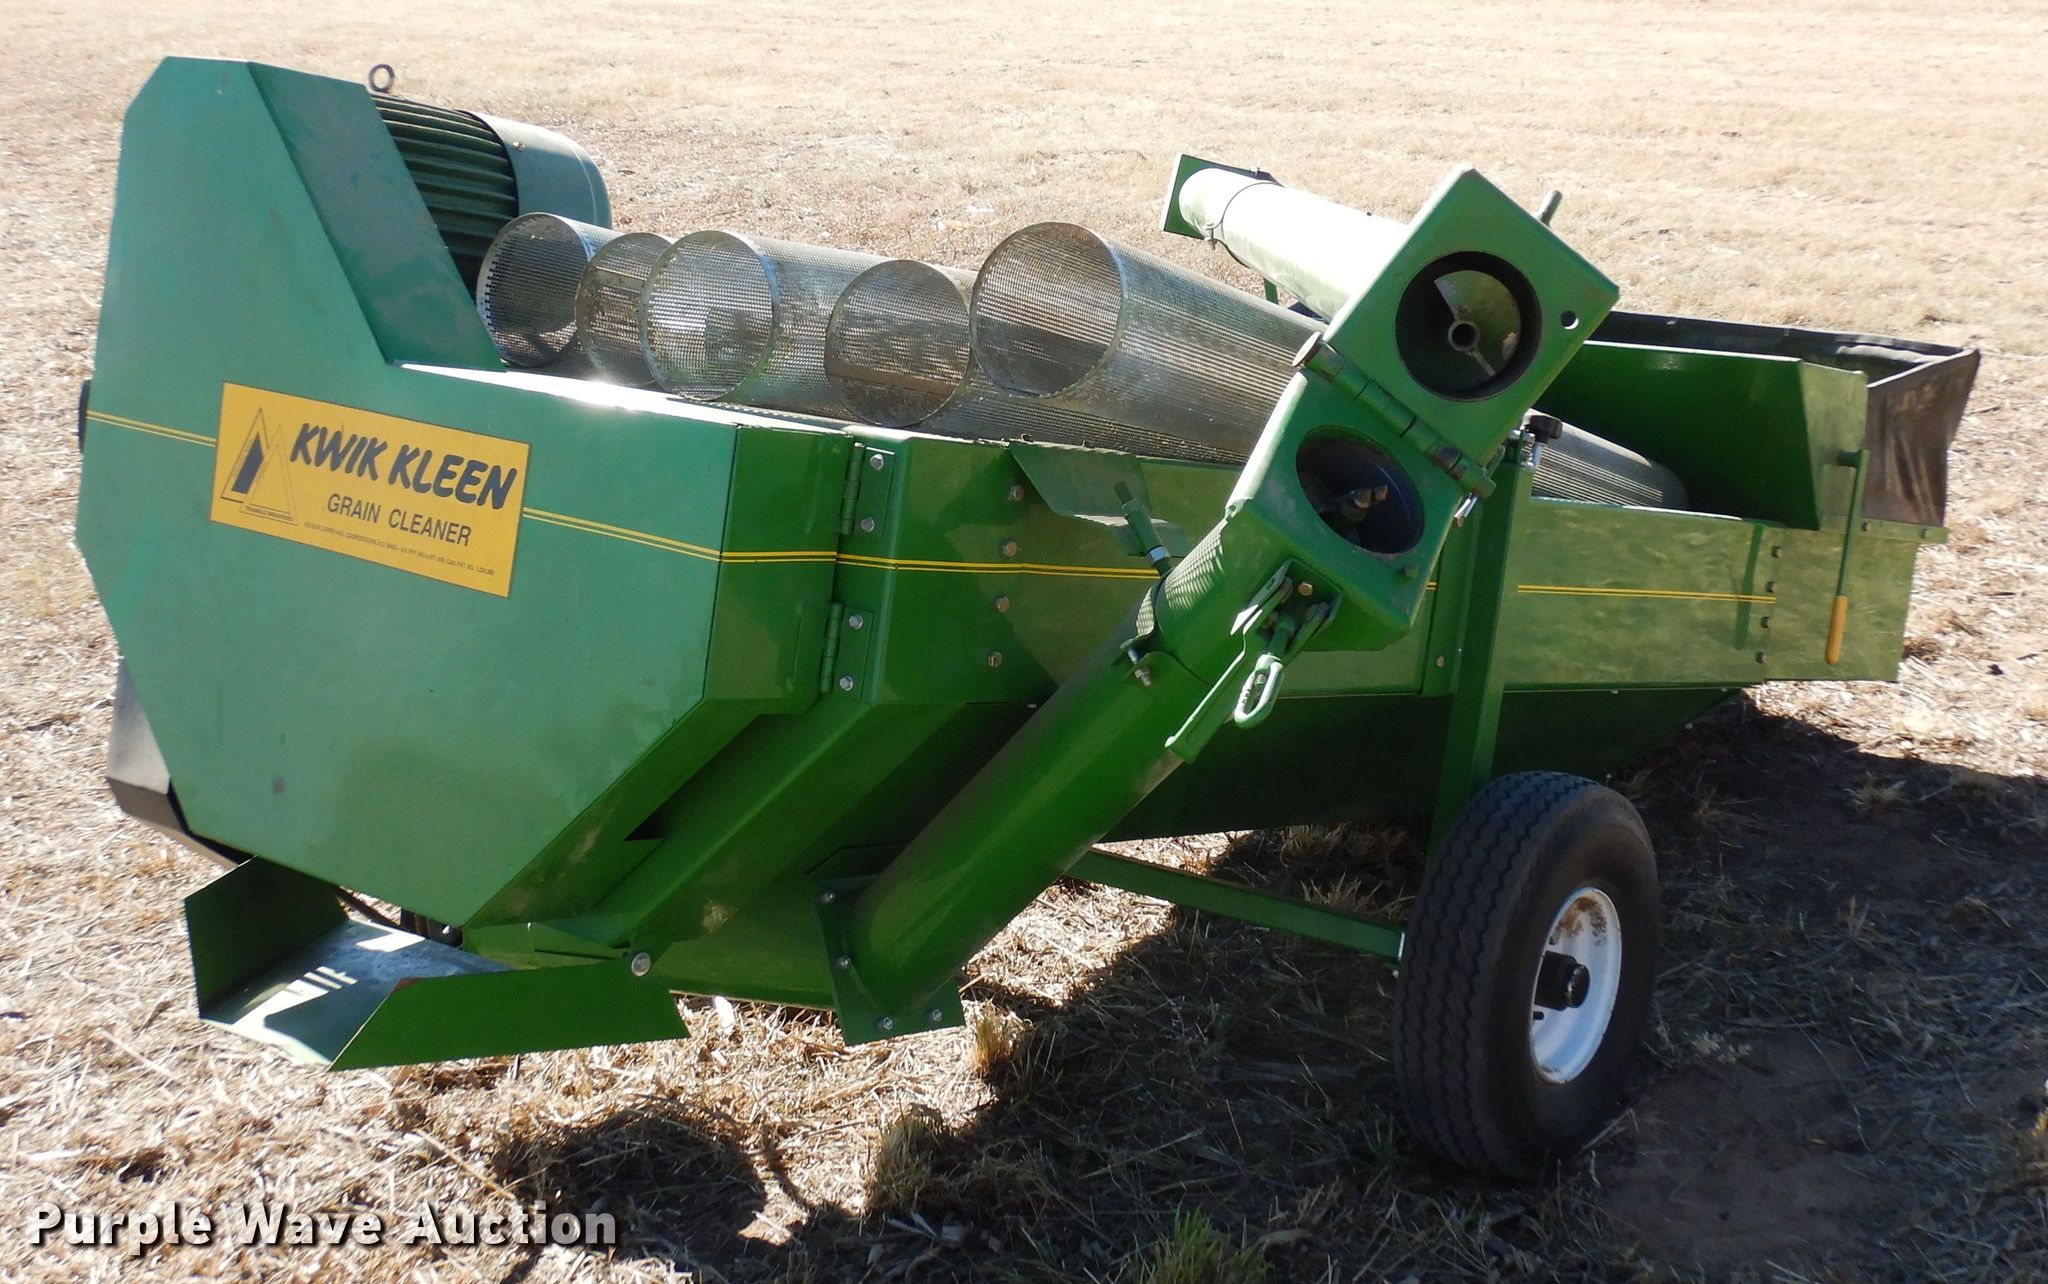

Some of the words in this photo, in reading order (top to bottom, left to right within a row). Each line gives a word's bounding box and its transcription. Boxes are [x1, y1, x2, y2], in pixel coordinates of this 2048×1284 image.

[290, 422, 388, 481] KWIK
[388, 443, 518, 510] KLEEN
[327, 493, 382, 524] GRAIN
[388, 508, 473, 548] CLEANER
